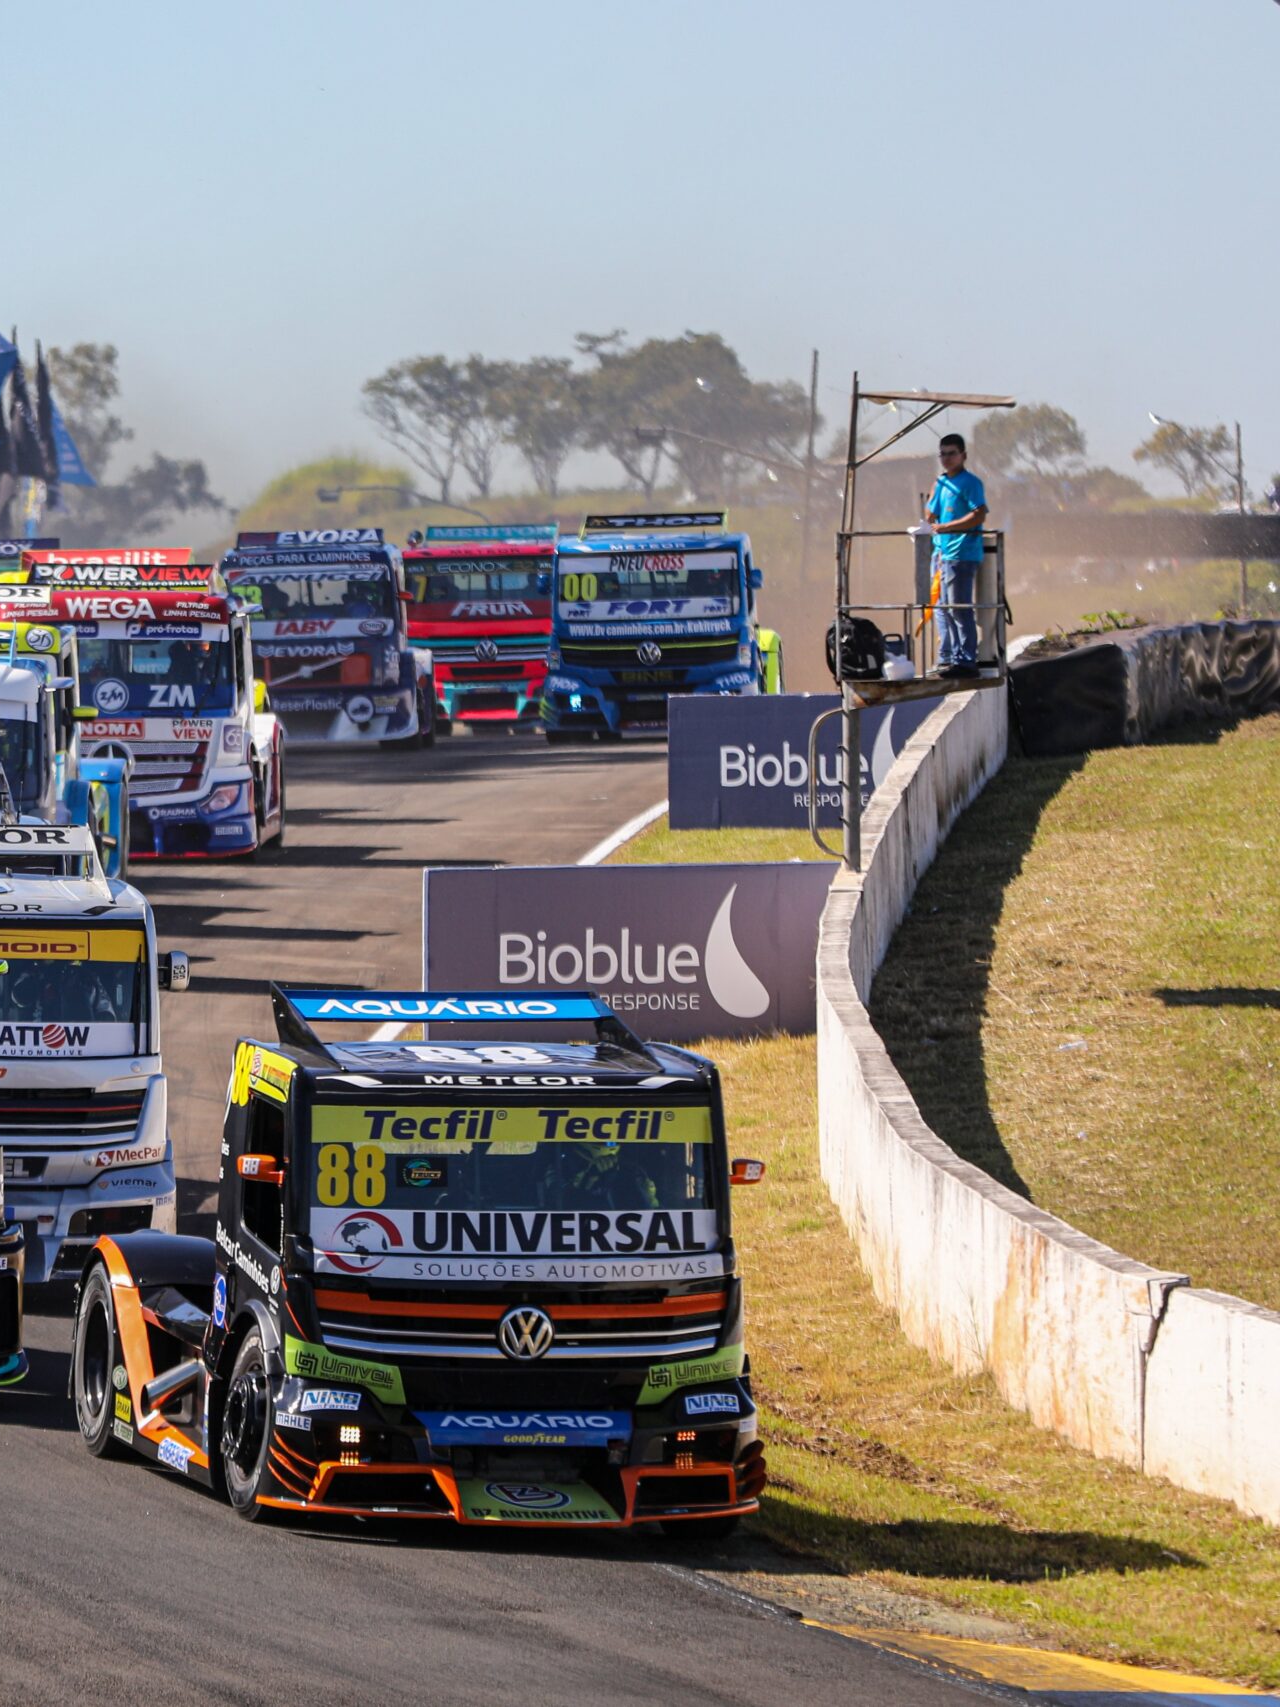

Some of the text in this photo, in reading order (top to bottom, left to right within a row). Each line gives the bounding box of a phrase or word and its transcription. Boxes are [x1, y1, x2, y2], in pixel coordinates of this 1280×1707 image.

[276, 529, 380, 544] EVORA
[609, 543, 686, 551] METEOR
[277, 553, 305, 563] PARA
[308, 550, 370, 562] CAMINHÕES
[610, 554, 685, 571] PNEUCROSS
[564, 573, 597, 601] 00
[65, 598, 156, 619] WEGA
[163, 610, 187, 618] LINHA
[607, 600, 690, 615] FORT
[273, 645, 339, 658] EVORA
[148, 685, 196, 708] ZM
[80, 722, 141, 737] NOMA
[173, 729, 213, 740] VIEW
[500, 927, 700, 984] Bioblue
[318, 997, 557, 1015] AQUÁRIO
[599, 993, 700, 1011] RESPONSE
[403, 1045, 553, 1064] 88
[425, 1075, 595, 1086] METEOR
[115, 1147, 161, 1162] MecPar
[317, 1144, 387, 1208] 88
[413, 1211, 707, 1253] UNIVERSAL
[414, 1260, 708, 1280] SOLUÇÕES AUTOMOTIVAS
[277, 1413, 311, 1430] MAHLE
[440, 1414, 614, 1428] AQUÁRIO
[499, 1508, 611, 1519] AUTOMOTIVE
